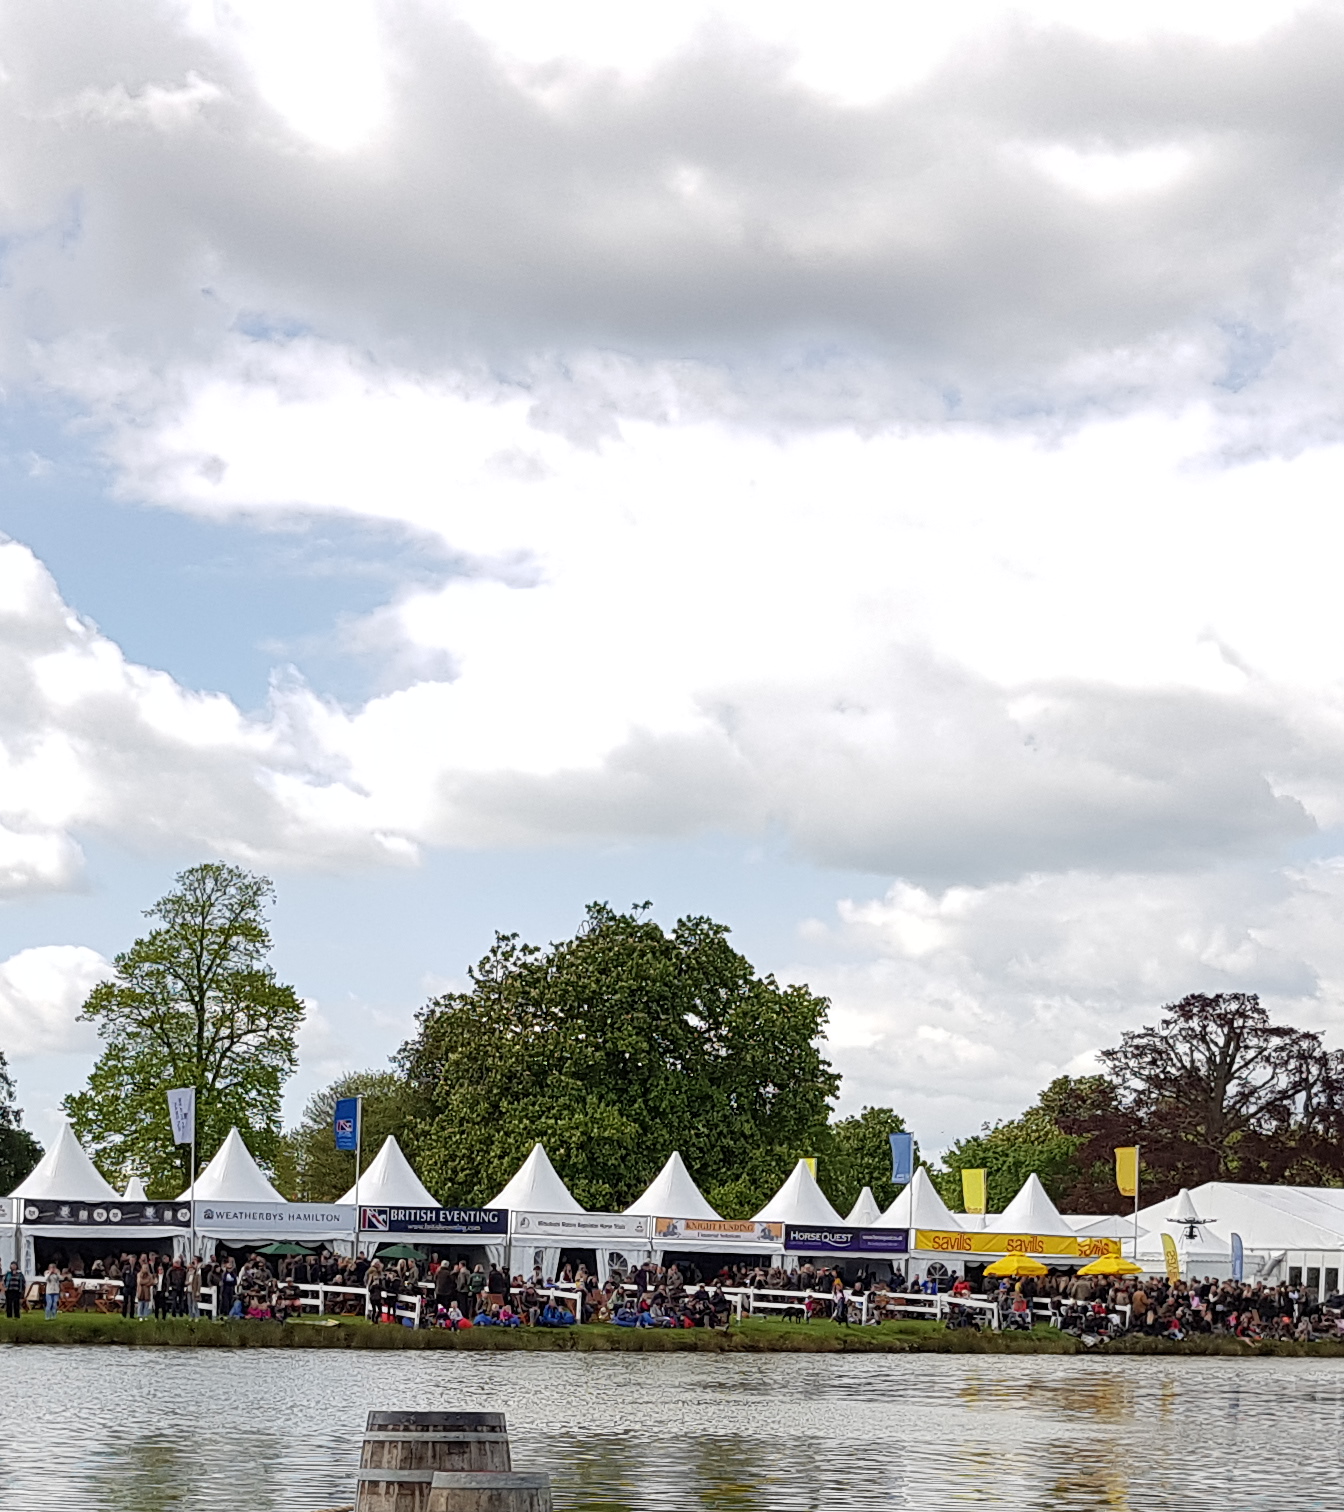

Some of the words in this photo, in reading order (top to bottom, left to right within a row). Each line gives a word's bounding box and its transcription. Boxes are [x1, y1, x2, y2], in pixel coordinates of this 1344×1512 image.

[215, 1211, 284, 1221] WEATHERBYS
[288, 1213, 341, 1222] HAMILTON
[390, 1209, 436, 1222] BRITISH
[439, 1210, 499, 1223] EVENTING
[685, 1221, 717, 1230] KNIGHT
[718, 1222, 755, 1232] FUNDING
[932, 1233, 972, 1251] savills
[1007, 1235, 1044, 1253] savills
